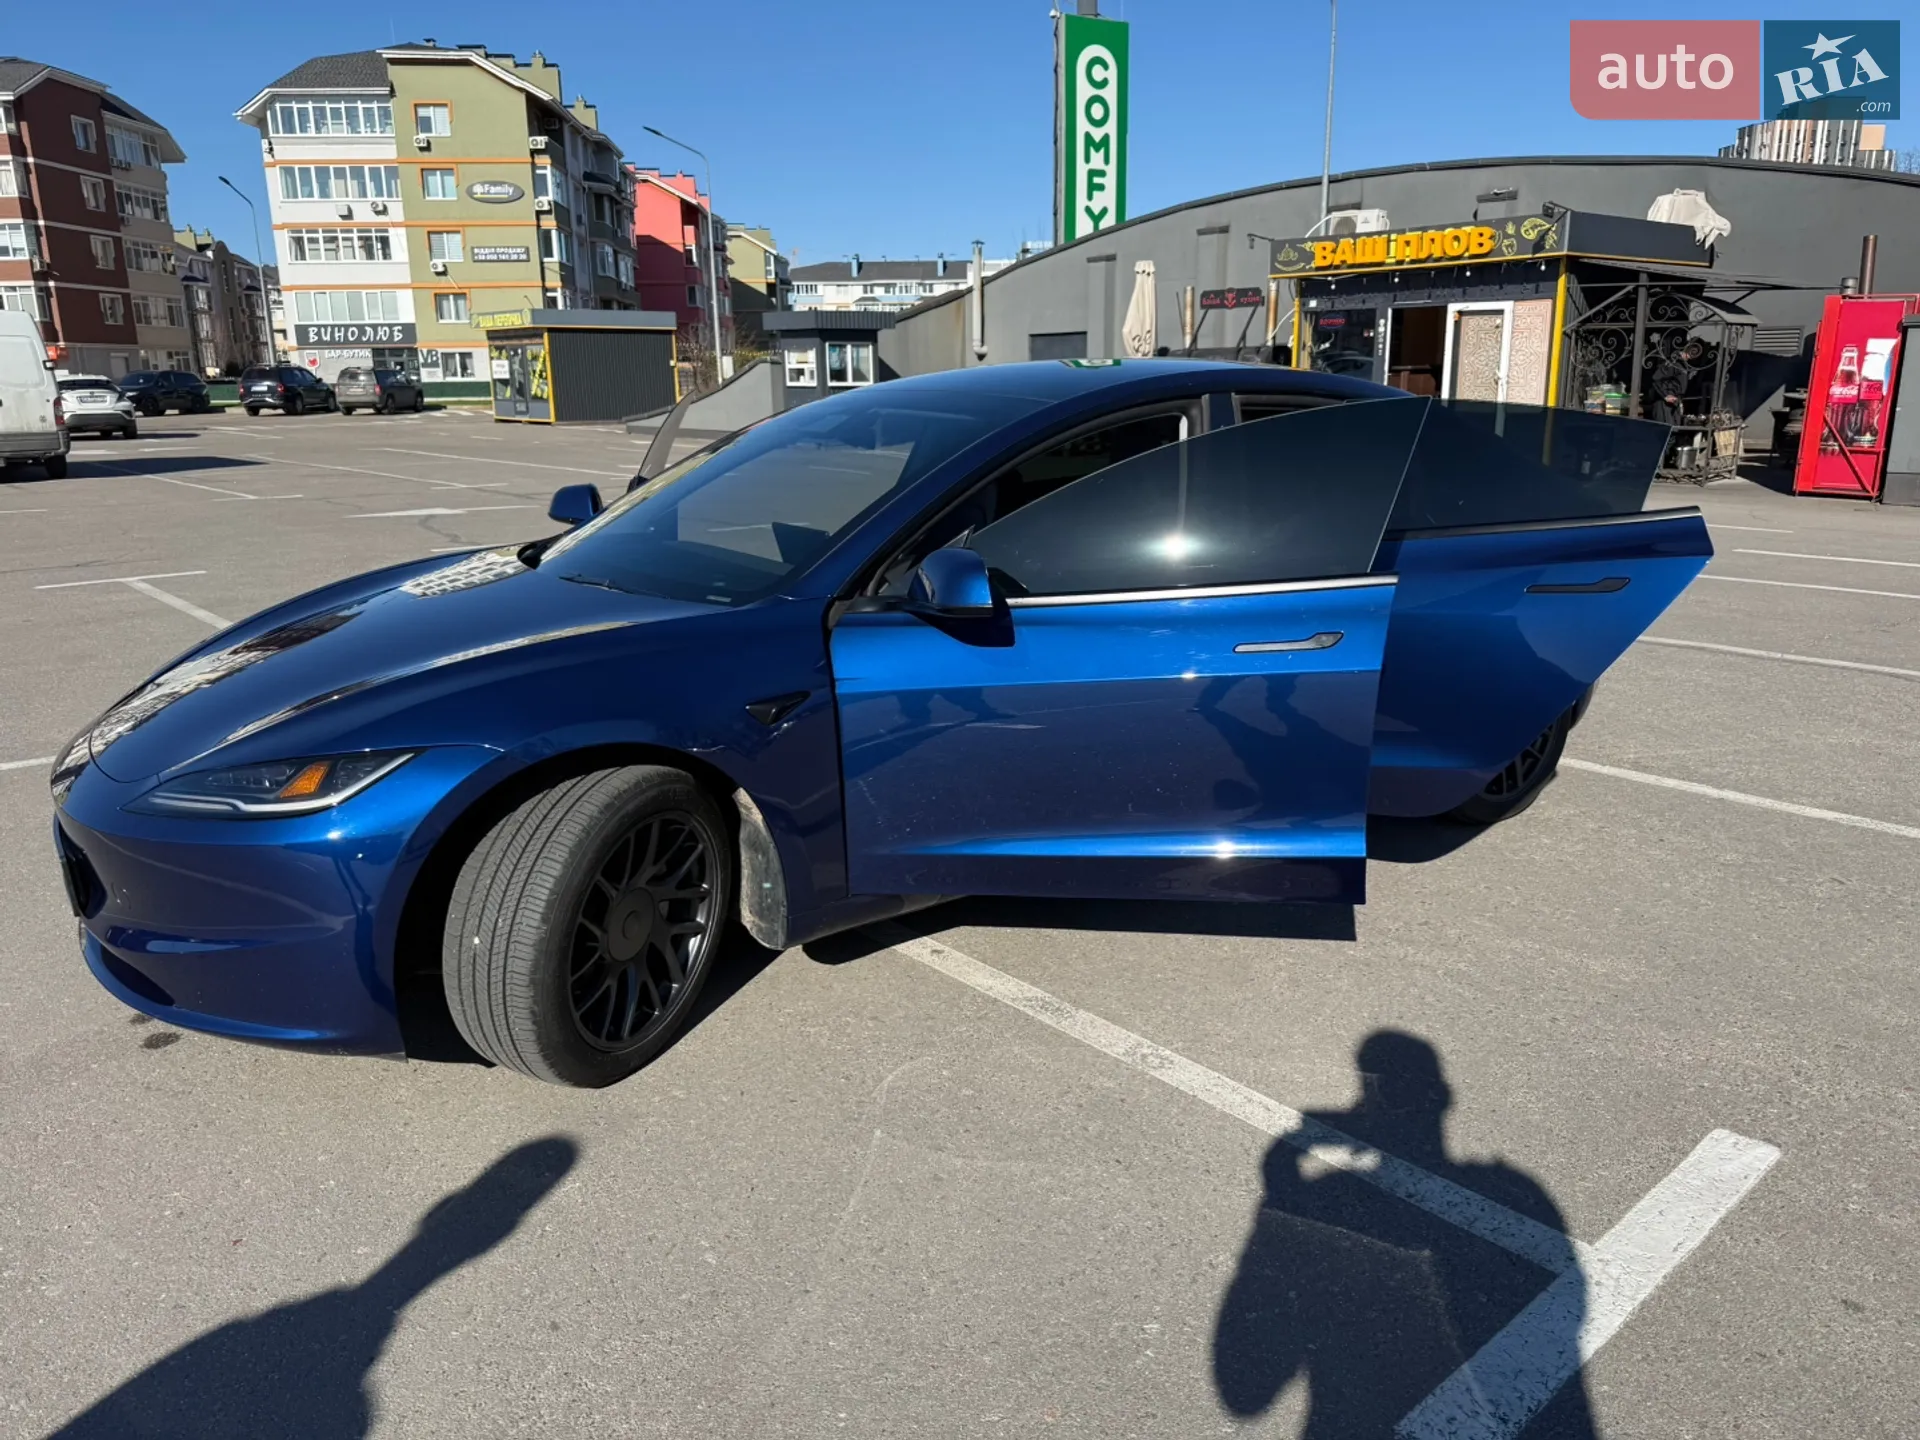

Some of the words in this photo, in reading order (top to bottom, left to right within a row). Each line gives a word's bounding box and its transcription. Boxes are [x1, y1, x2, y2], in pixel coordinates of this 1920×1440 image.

[1084, 56, 1110, 232] COMFY
[484, 184, 514, 195] Family
[1313, 234, 1387, 268] ВАШ
[1395, 226, 1496, 262] ПЛОВ
[308, 326, 403, 342] ВИНОЛЮБ
